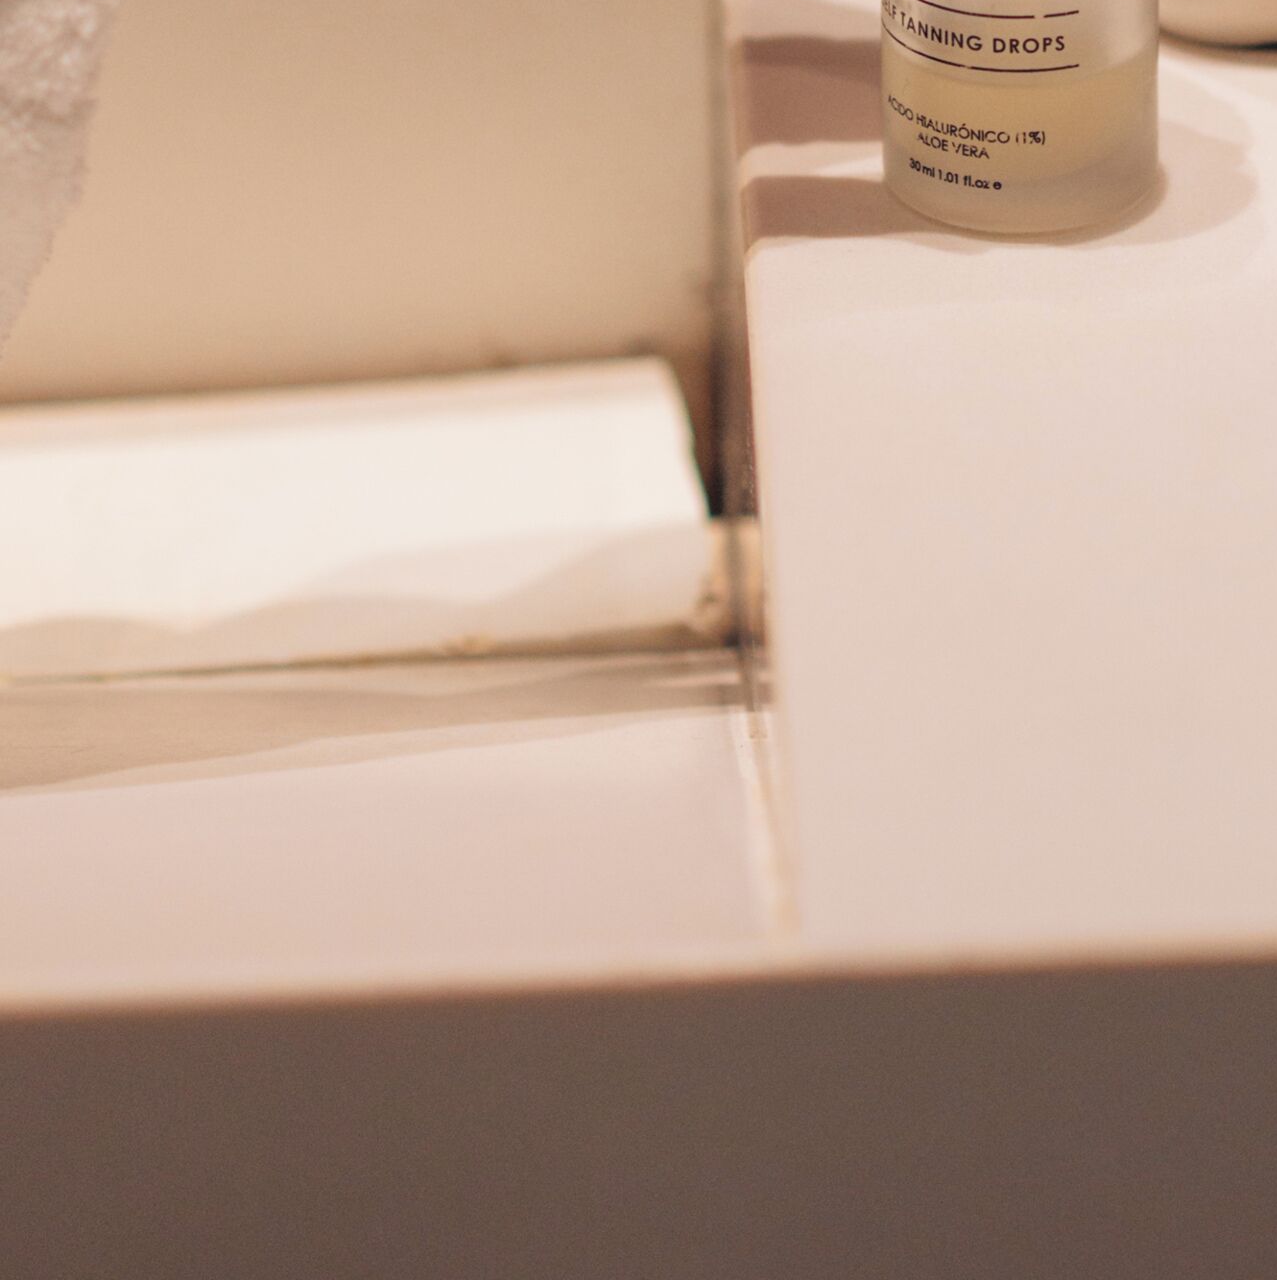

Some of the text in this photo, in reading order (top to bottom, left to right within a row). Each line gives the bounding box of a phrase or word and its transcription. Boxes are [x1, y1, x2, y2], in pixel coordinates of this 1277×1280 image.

[900, 11, 983, 52] TANNING
[992, 35, 1066, 54] DROPS
[916, 112, 1011, 144] HIALURÓNICO
[1015, 130, 1046, 145] (1%)
[918, 132, 990, 160] ALOE VERA
[938, 169, 959, 184] 1.01
